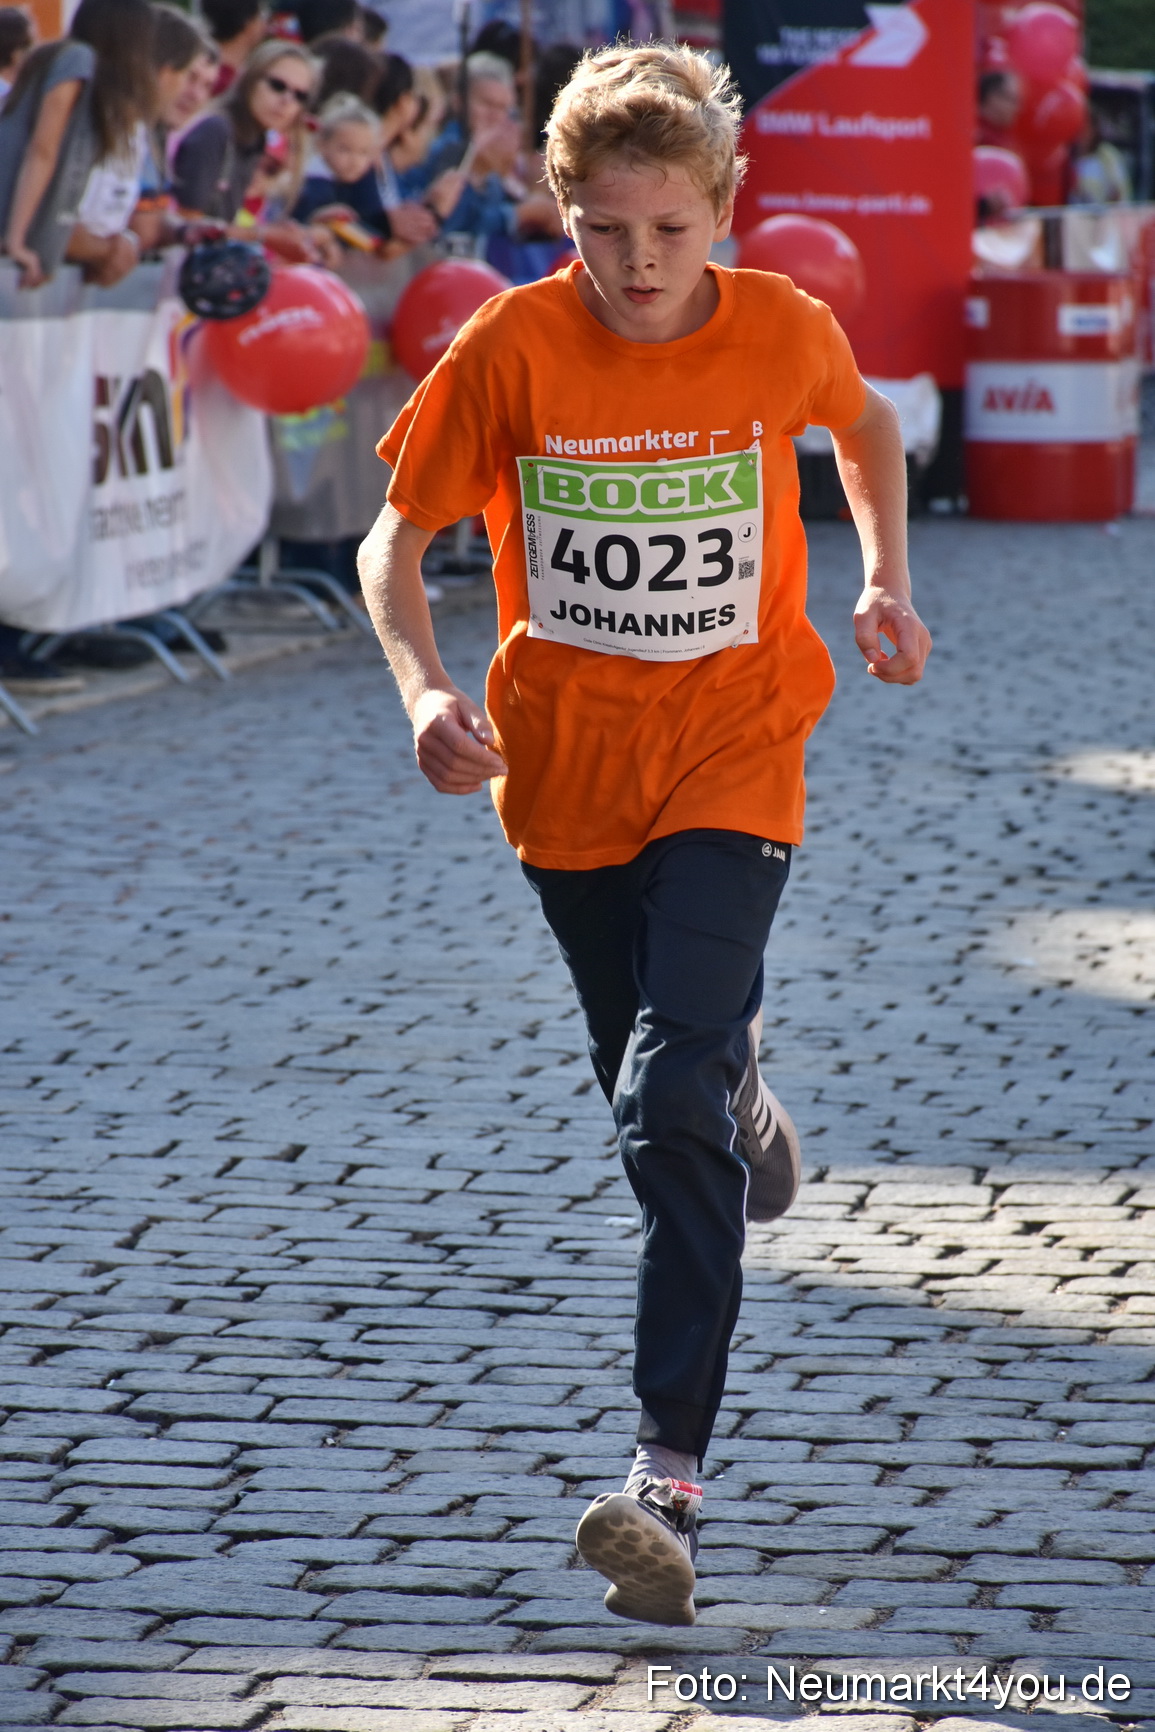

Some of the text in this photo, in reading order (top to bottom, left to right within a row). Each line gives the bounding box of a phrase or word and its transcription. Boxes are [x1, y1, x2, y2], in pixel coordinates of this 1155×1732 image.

[545, 429, 699, 455] Neumarkter
[540, 464, 741, 514] BOCK
[743, 526, 752, 538] J
[550, 527, 735, 592] 4023
[550, 599, 736, 637] JOHANNES
